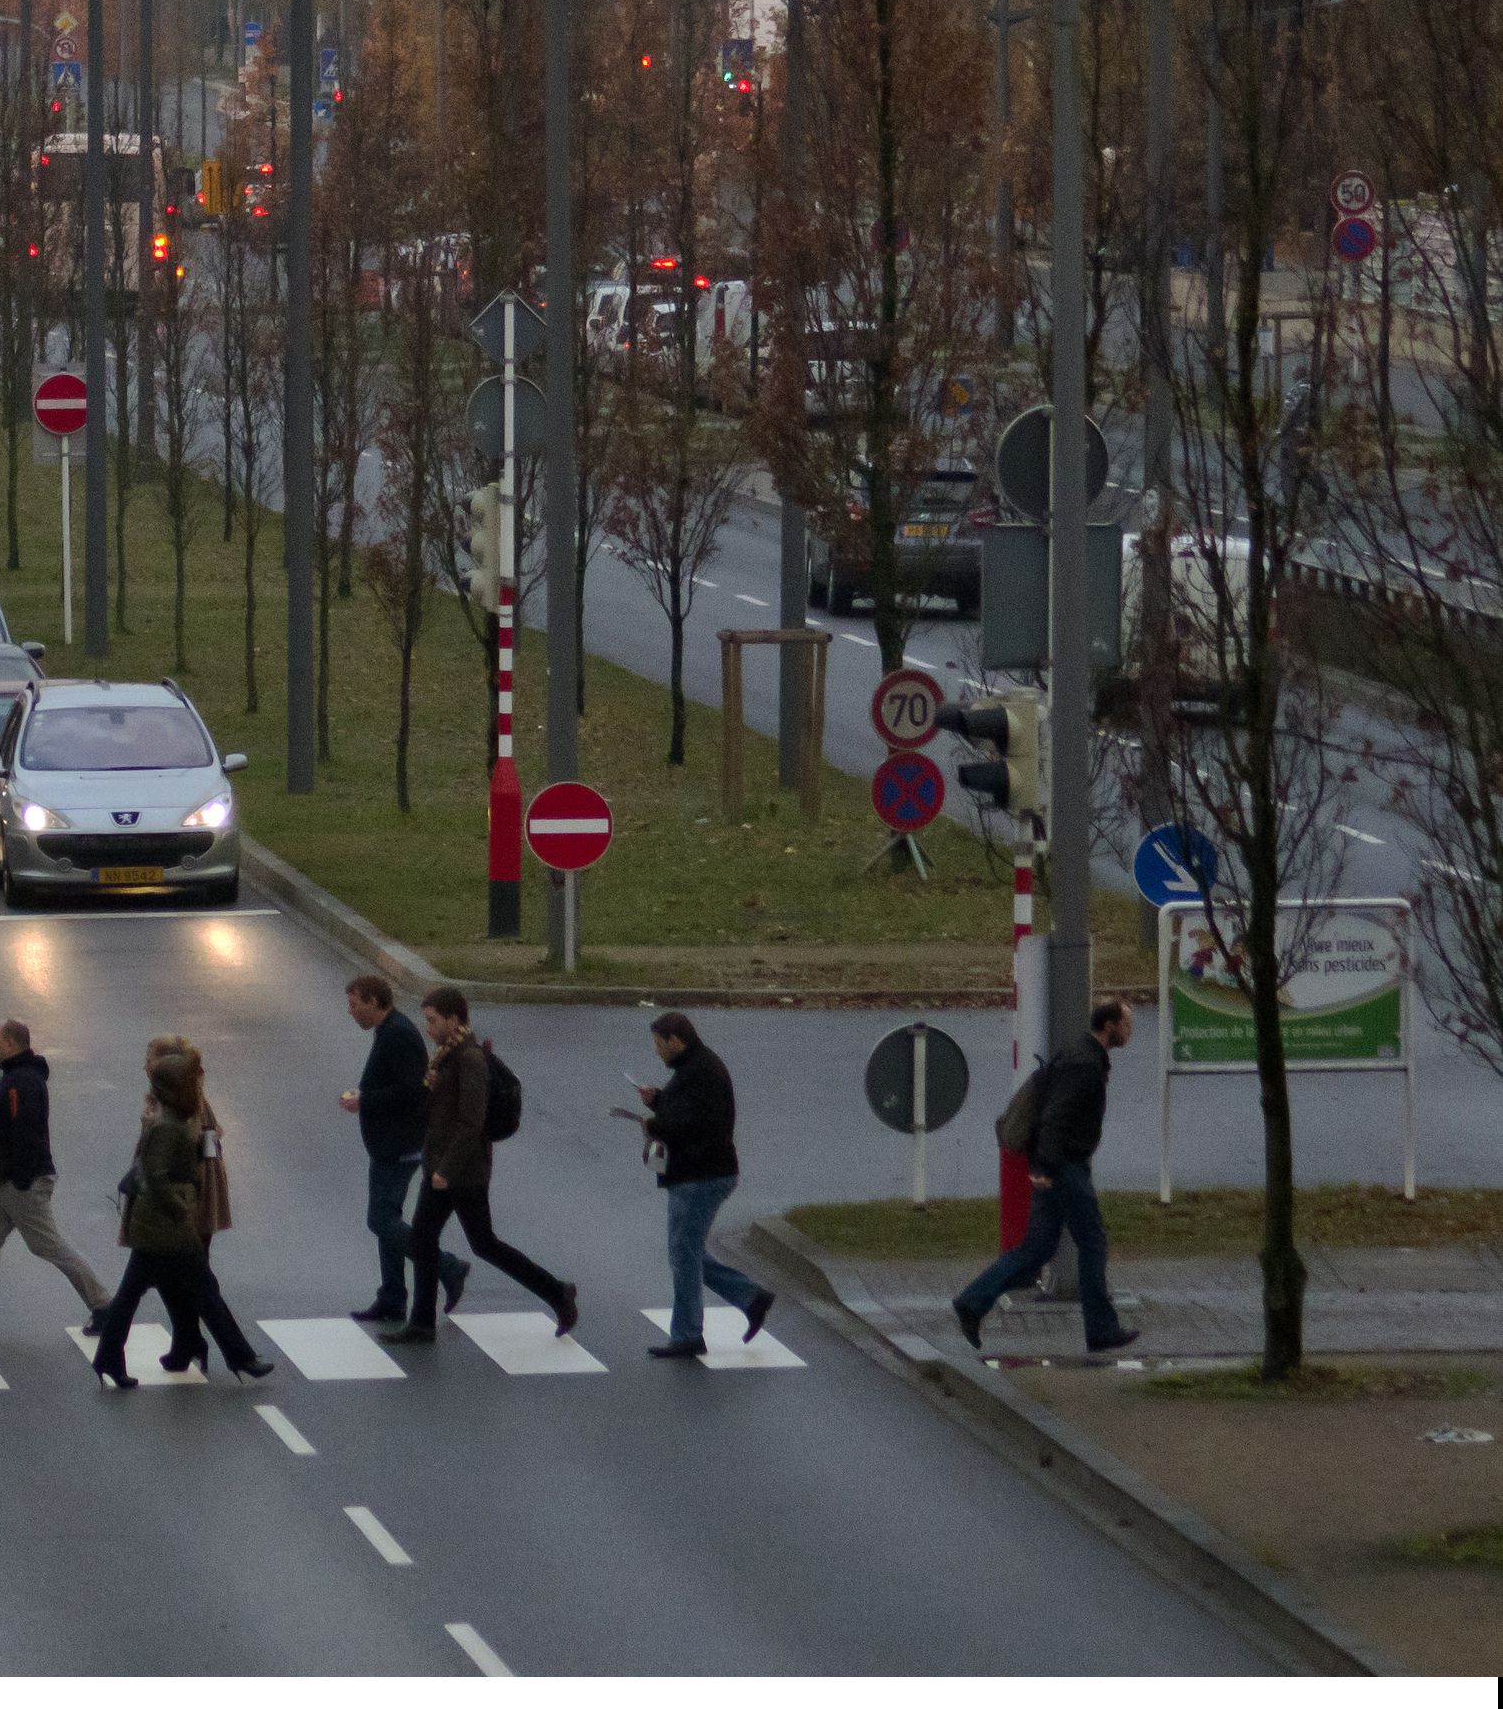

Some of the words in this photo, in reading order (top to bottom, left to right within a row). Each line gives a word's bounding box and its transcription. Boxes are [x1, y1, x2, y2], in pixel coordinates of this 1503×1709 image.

[1342, 184, 1365, 203] 50
[889, 692, 927, 727] 70
[1336, 938, 1374, 951] mieux
[1324, 955, 1385, 976] pesticides
